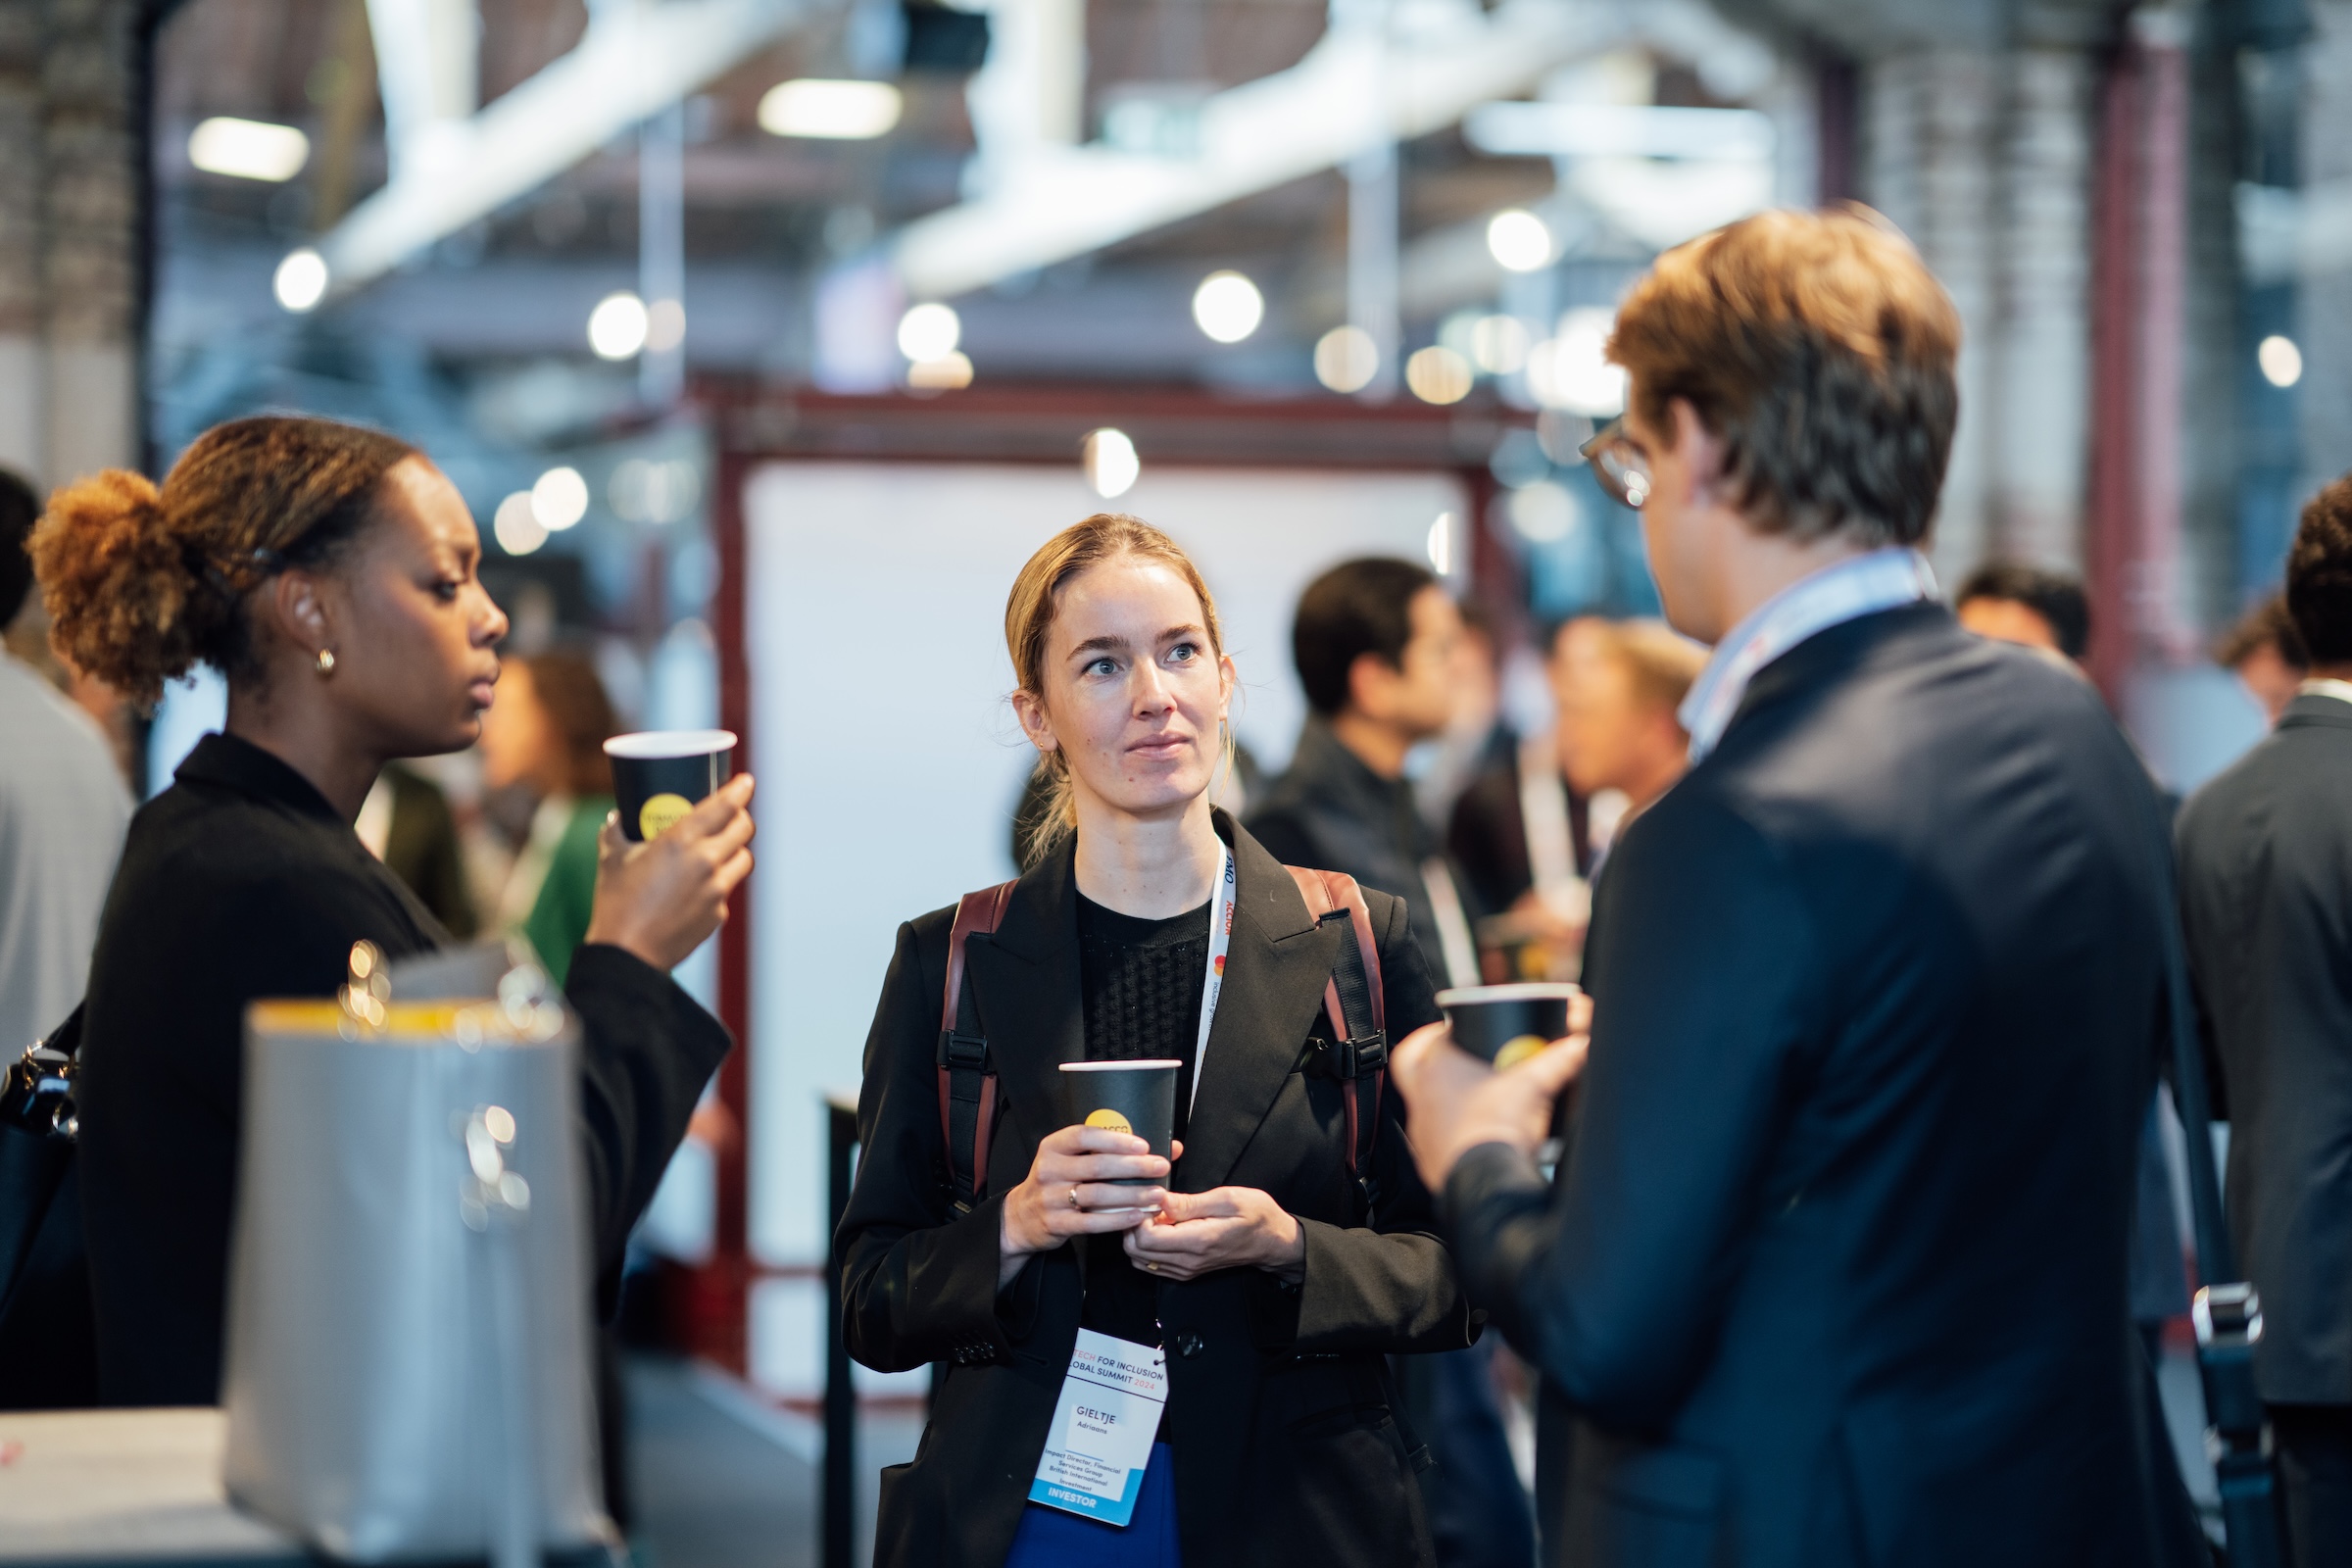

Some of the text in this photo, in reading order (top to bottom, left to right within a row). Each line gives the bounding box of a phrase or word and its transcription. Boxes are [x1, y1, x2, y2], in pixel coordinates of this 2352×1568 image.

[1224, 855, 1234, 884] FMO
[1210, 981, 1220, 1007] inclusive
[1069, 1360, 1155, 1391] OBAL SUMMIT 2024
[1097, 1355, 1115, 1367] FOR
[1117, 1361, 1164, 1381] INCLUSION
[1076, 1405, 1116, 1425] GIELTJE
[1077, 1421, 1107, 1435] Adriaans
[1045, 1447, 1066, 1459] Impact
[1094, 1461, 1121, 1475] Financial
[1058, 1459, 1103, 1478] Services Group
[1049, 1465, 1108, 1487] British International
[1058, 1478, 1092, 1492] Investment
[1048, 1487, 1097, 1508] INVESTOR
